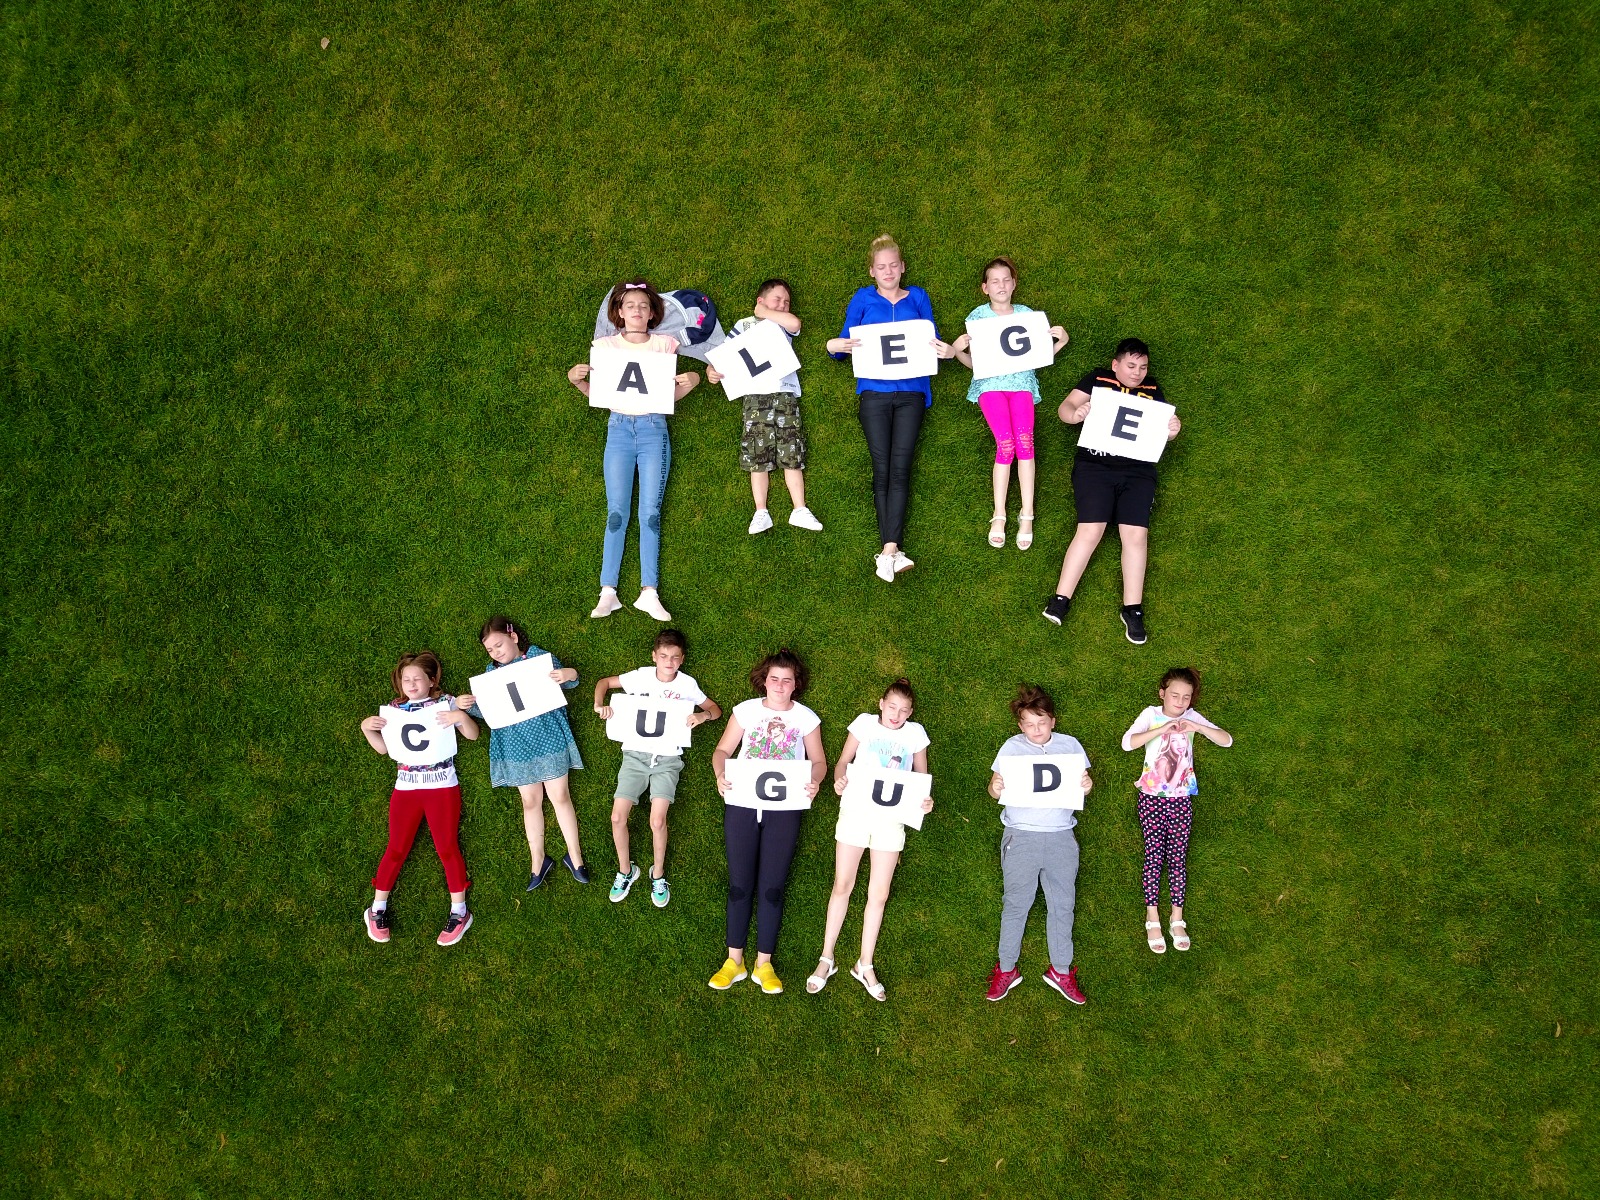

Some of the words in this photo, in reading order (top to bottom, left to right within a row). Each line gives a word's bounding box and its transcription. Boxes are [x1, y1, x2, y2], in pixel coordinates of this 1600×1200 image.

[880, 334, 908, 365] E
[1000, 326, 1032, 356] G
[738, 348, 773, 377] L
[617, 362, 648, 394] A
[1111, 406, 1143, 441] E
[507, 682, 525, 712] I
[401, 724, 430, 751] C
[636, 709, 666, 737] U
[756, 772, 786, 801] G
[1033, 764, 1061, 792] D
[872, 780, 904, 806] U
